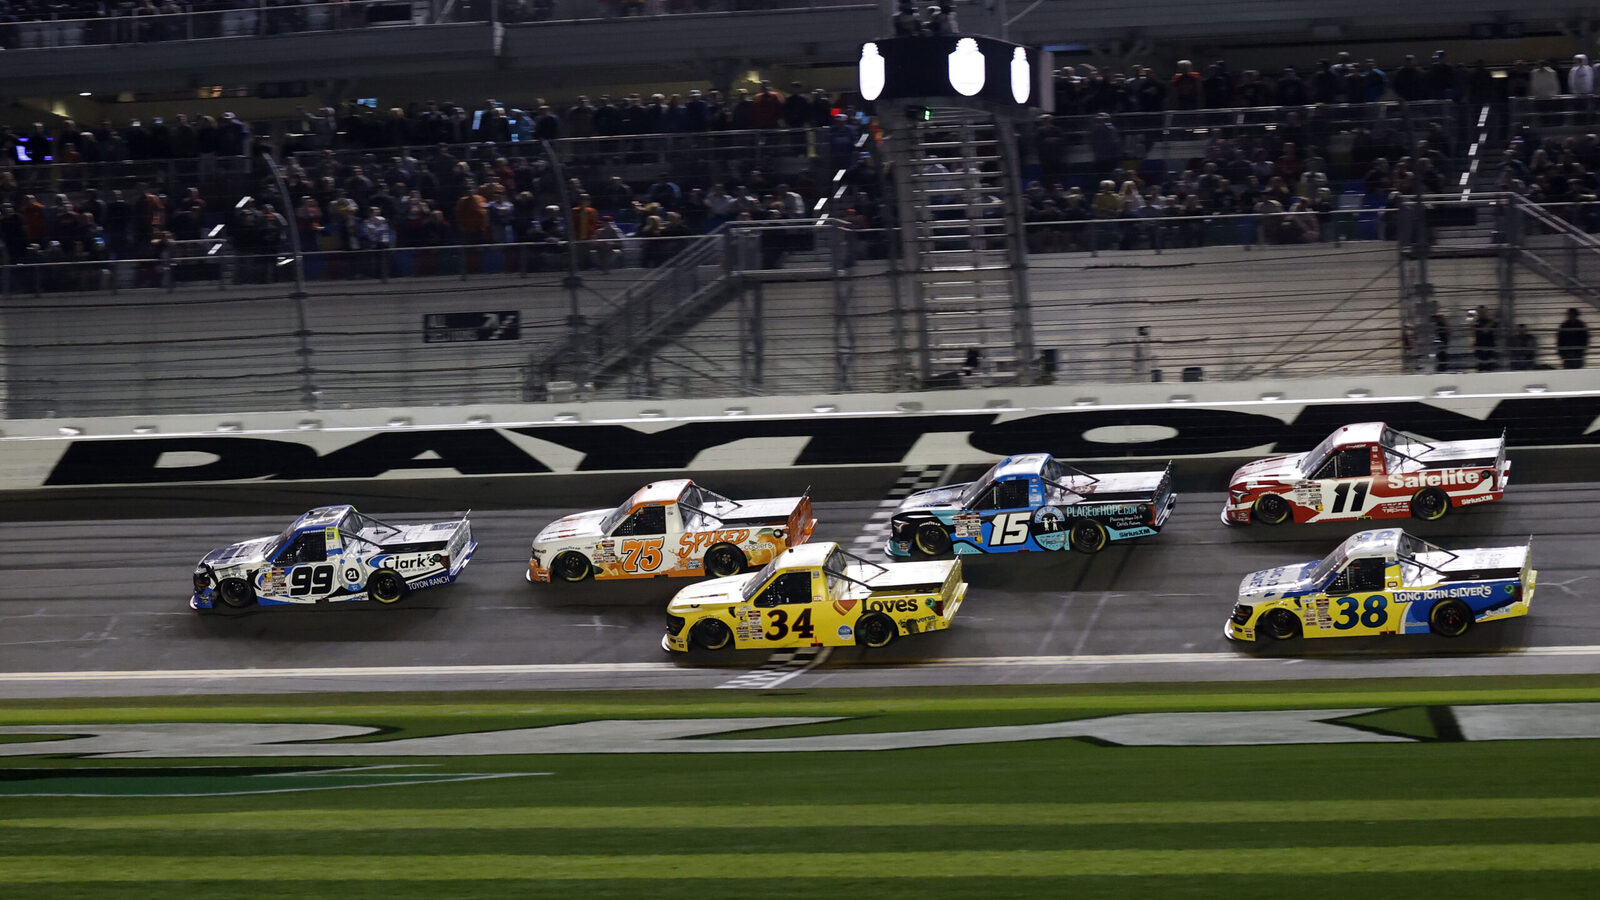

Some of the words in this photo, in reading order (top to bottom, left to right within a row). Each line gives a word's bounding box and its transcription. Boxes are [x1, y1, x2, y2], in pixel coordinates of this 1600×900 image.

[42, 397, 1600, 486] DAYTON
[1388, 469, 1479, 489] Safelite
[1331, 481, 1370, 514] 11
[1461, 494, 1494, 505] SiriusXM
[678, 528, 751, 558] SPIKED
[989, 511, 1032, 547] 15
[383, 553, 436, 570] Clark's
[621, 536, 665, 573] 75
[289, 564, 335, 598] 99
[347, 570, 358, 580] 21
[408, 580, 430, 591] TOYON
[430, 576, 450, 586] RANCH
[1394, 592, 1422, 603] LONG
[1423, 590, 1449, 601] JOHN
[1449, 585, 1493, 599] SILVER'S
[765, 607, 815, 641] 34
[1333, 594, 1389, 630] 38
